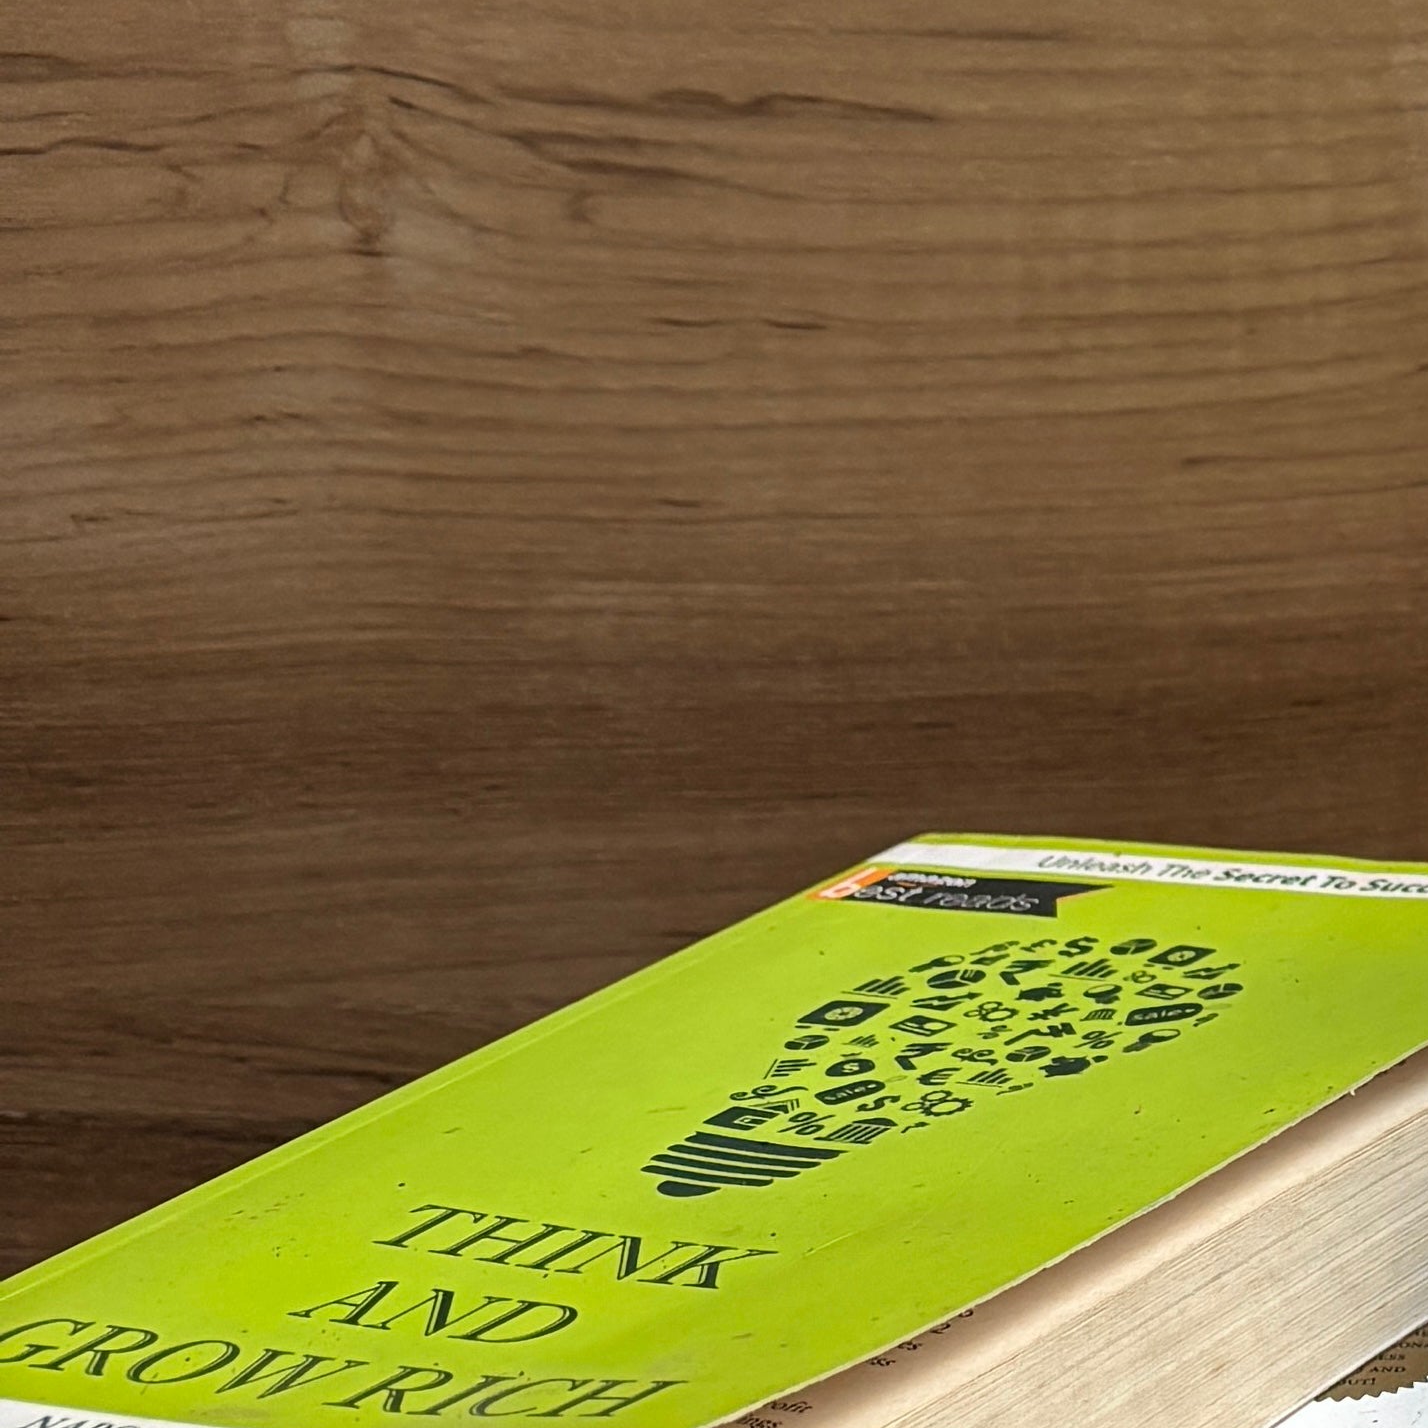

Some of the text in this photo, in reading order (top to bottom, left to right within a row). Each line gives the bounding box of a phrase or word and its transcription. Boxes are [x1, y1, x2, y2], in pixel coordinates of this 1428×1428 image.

[923, 890, 1040, 912] reads
[1037, 853, 1152, 876] Unleash
[1159, 862, 1207, 881] The
[1212, 868, 1319, 888] Secret
[1322, 874, 1354, 890] To
[373, 1204, 779, 1289] THINK
[287, 1280, 579, 1343] AND
[0, 1318, 689, 1417] GROW RICH
